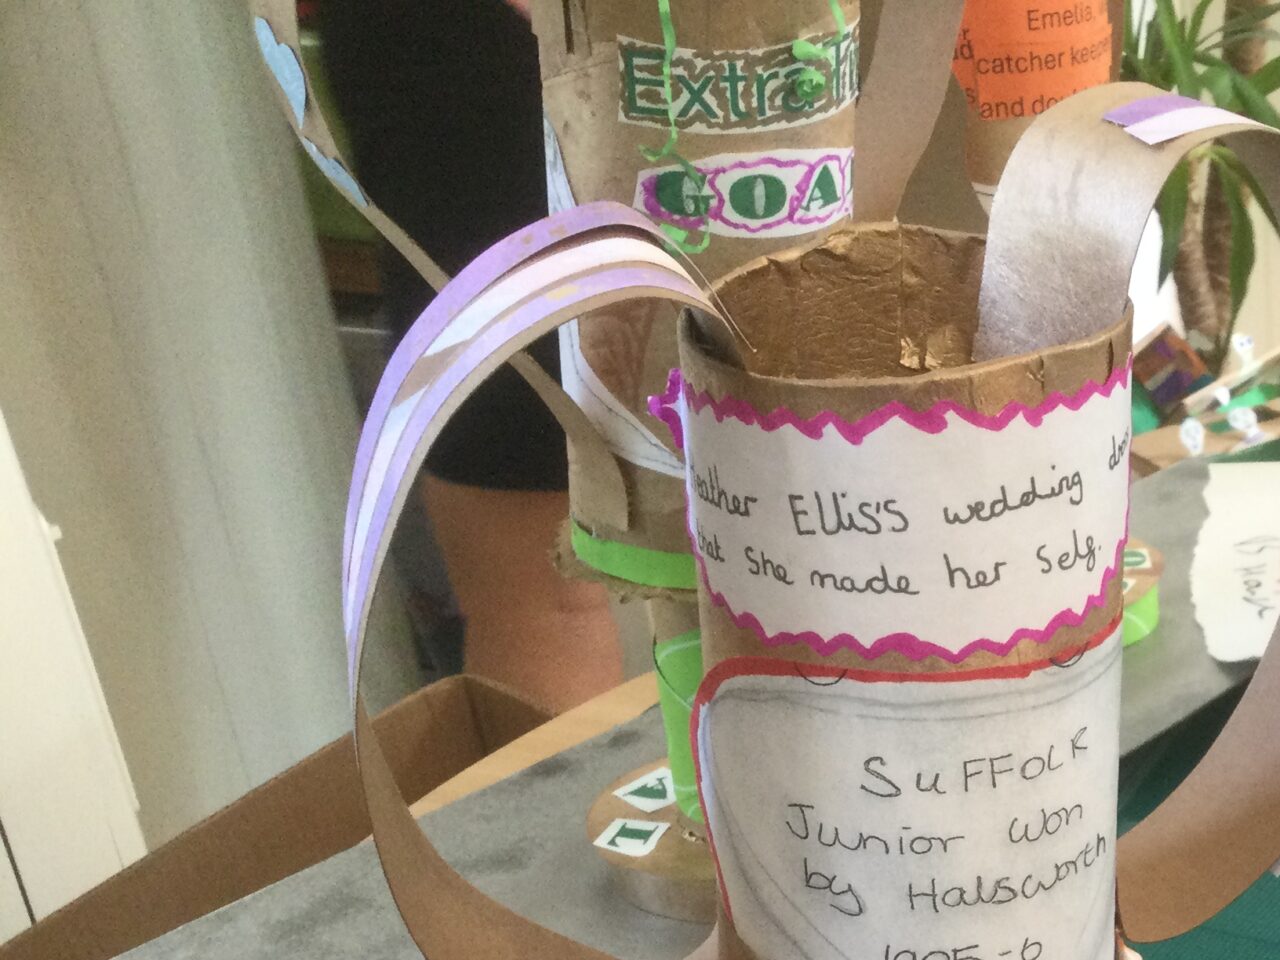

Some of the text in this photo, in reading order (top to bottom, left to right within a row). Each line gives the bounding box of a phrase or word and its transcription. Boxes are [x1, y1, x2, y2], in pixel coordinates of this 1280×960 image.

[976, 50, 1065, 75] catcher
[980, 96, 1024, 119] and
[656, 163, 853, 220] GOA
[944, 466, 1083, 526] wedding
[810, 565, 920, 595] made
[944, 554, 1008, 589] her
[785, 803, 966, 855] Junior
[803, 858, 864, 916] by
